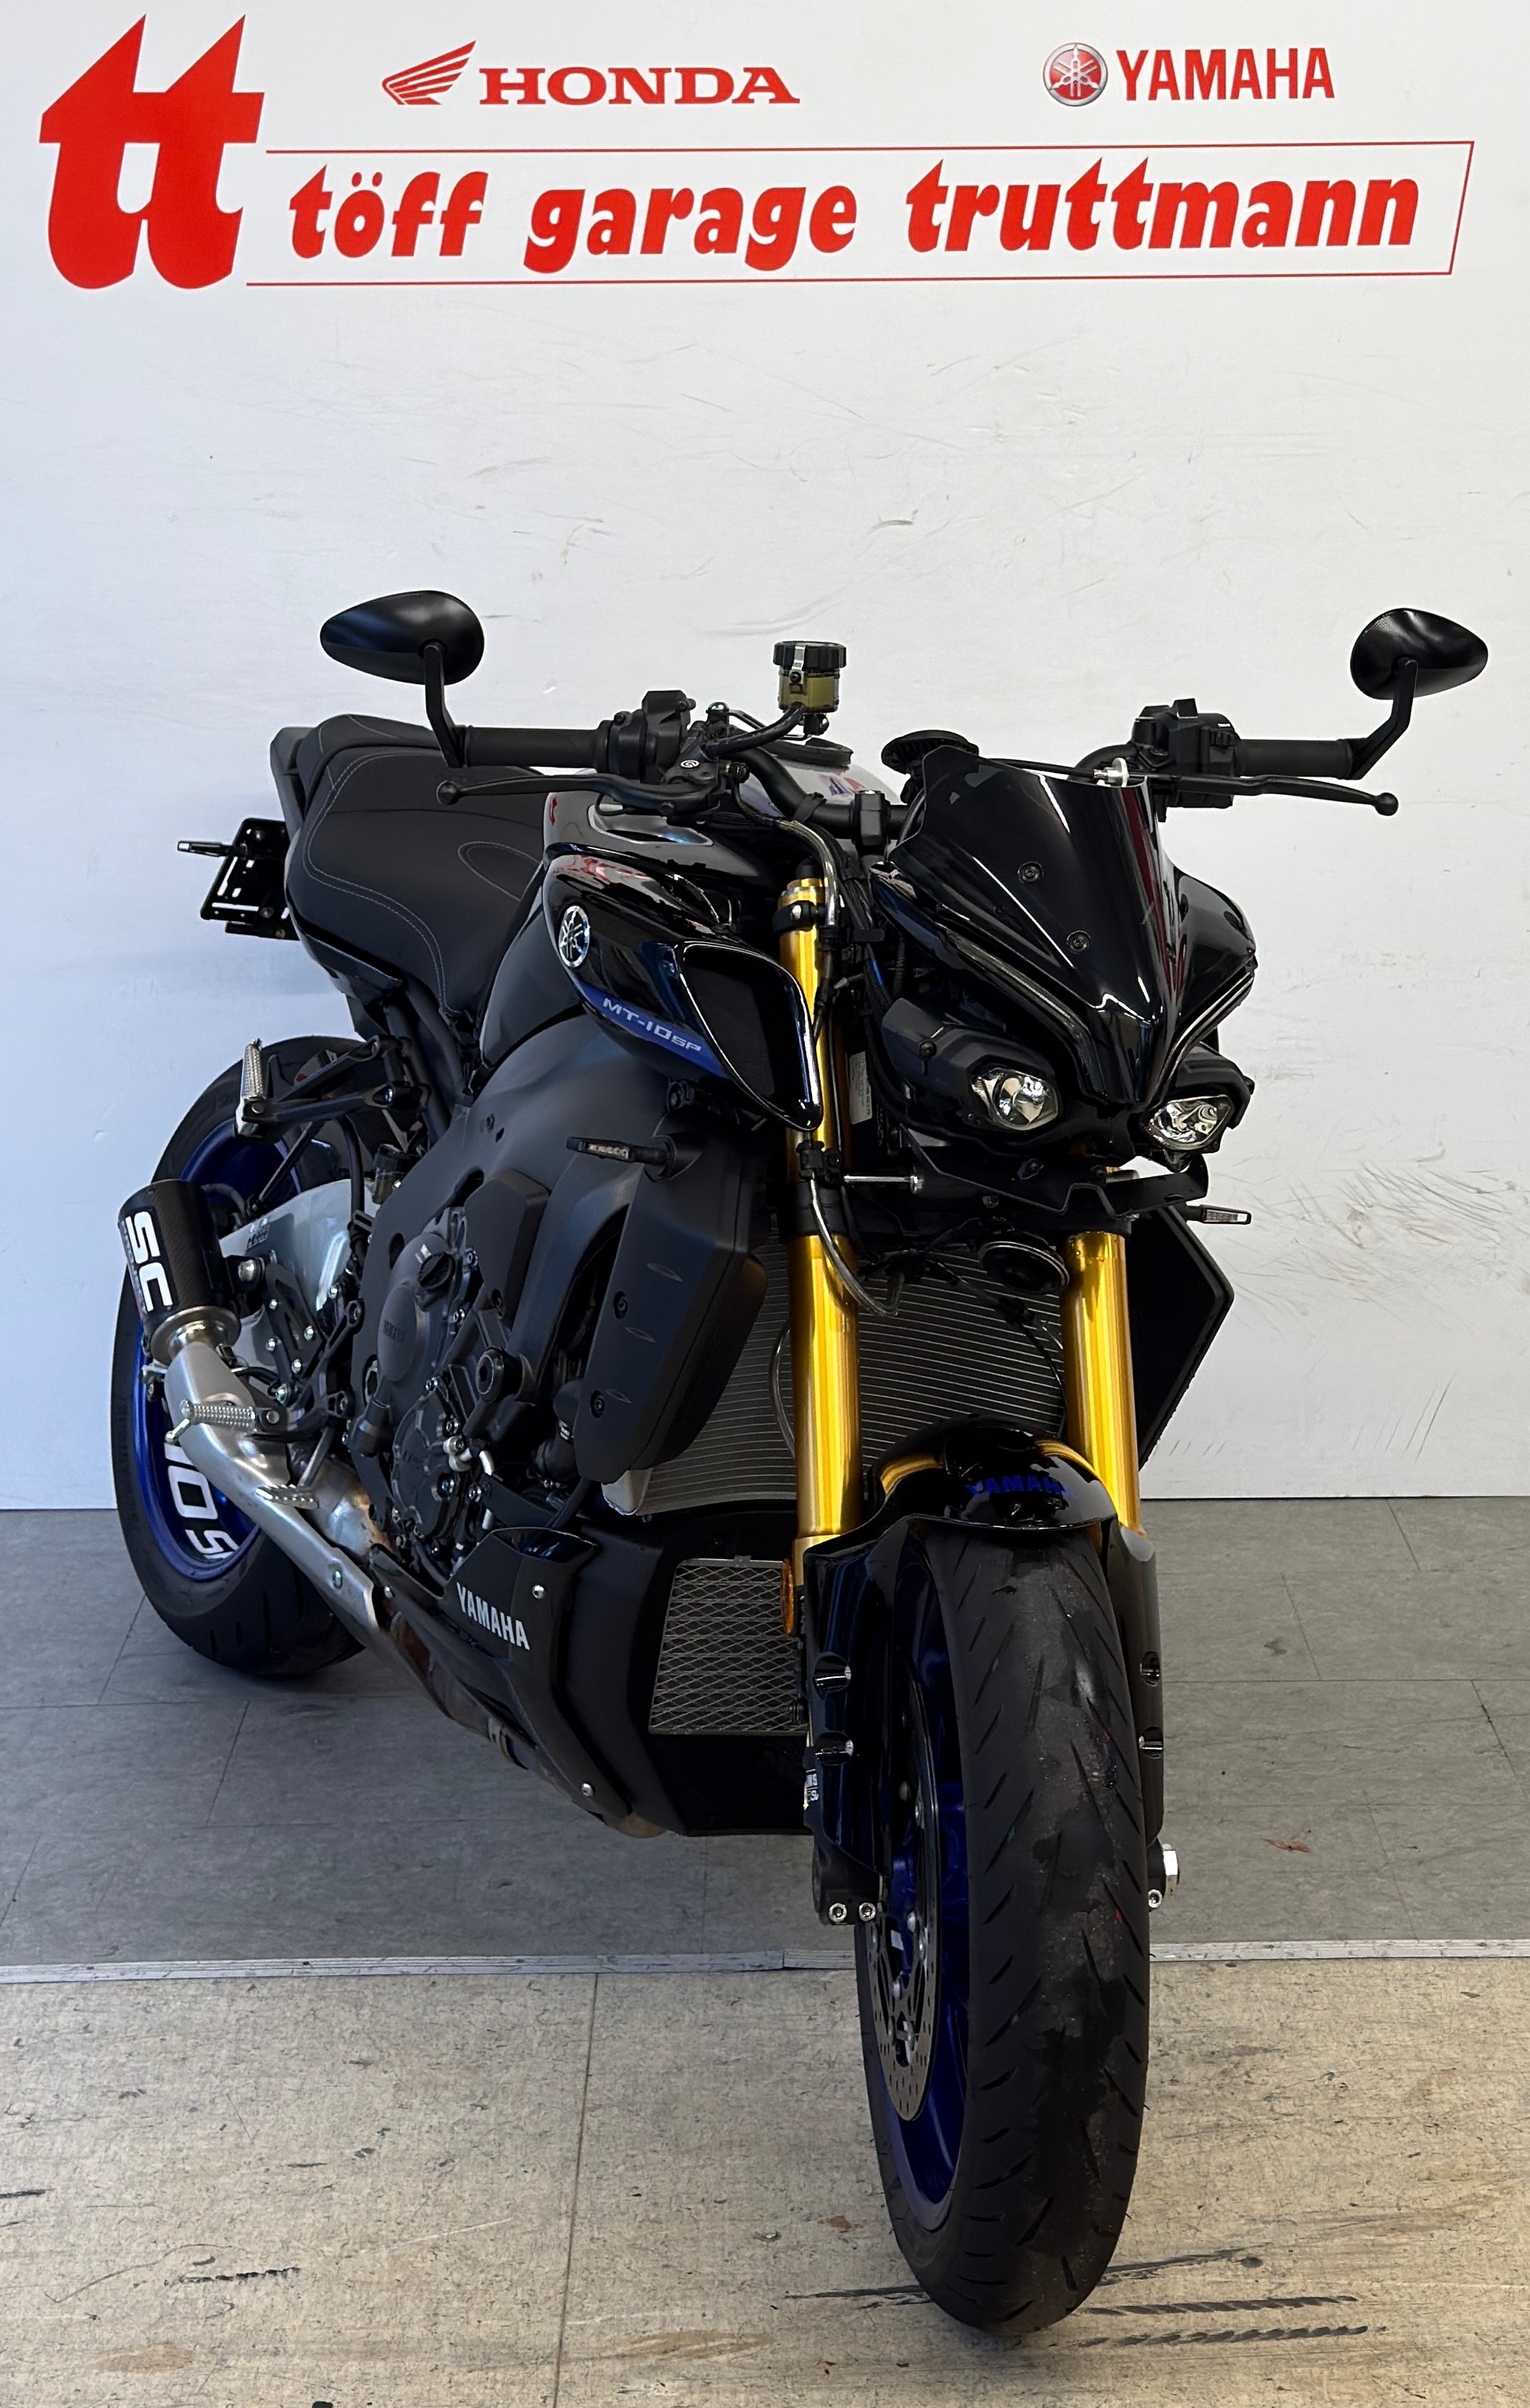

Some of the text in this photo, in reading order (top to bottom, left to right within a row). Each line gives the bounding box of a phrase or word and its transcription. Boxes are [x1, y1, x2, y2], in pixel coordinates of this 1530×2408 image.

[480, 67, 799, 105] HONDA
[1117, 48, 1334, 100] YAMAHA
[289, 157, 1418, 273] töff garage truttmann
[125, 1211, 173, 1312] SC
[964, 1475, 1077, 1500] YAMAHA
[456, 1581, 531, 1651] YAMAHA
